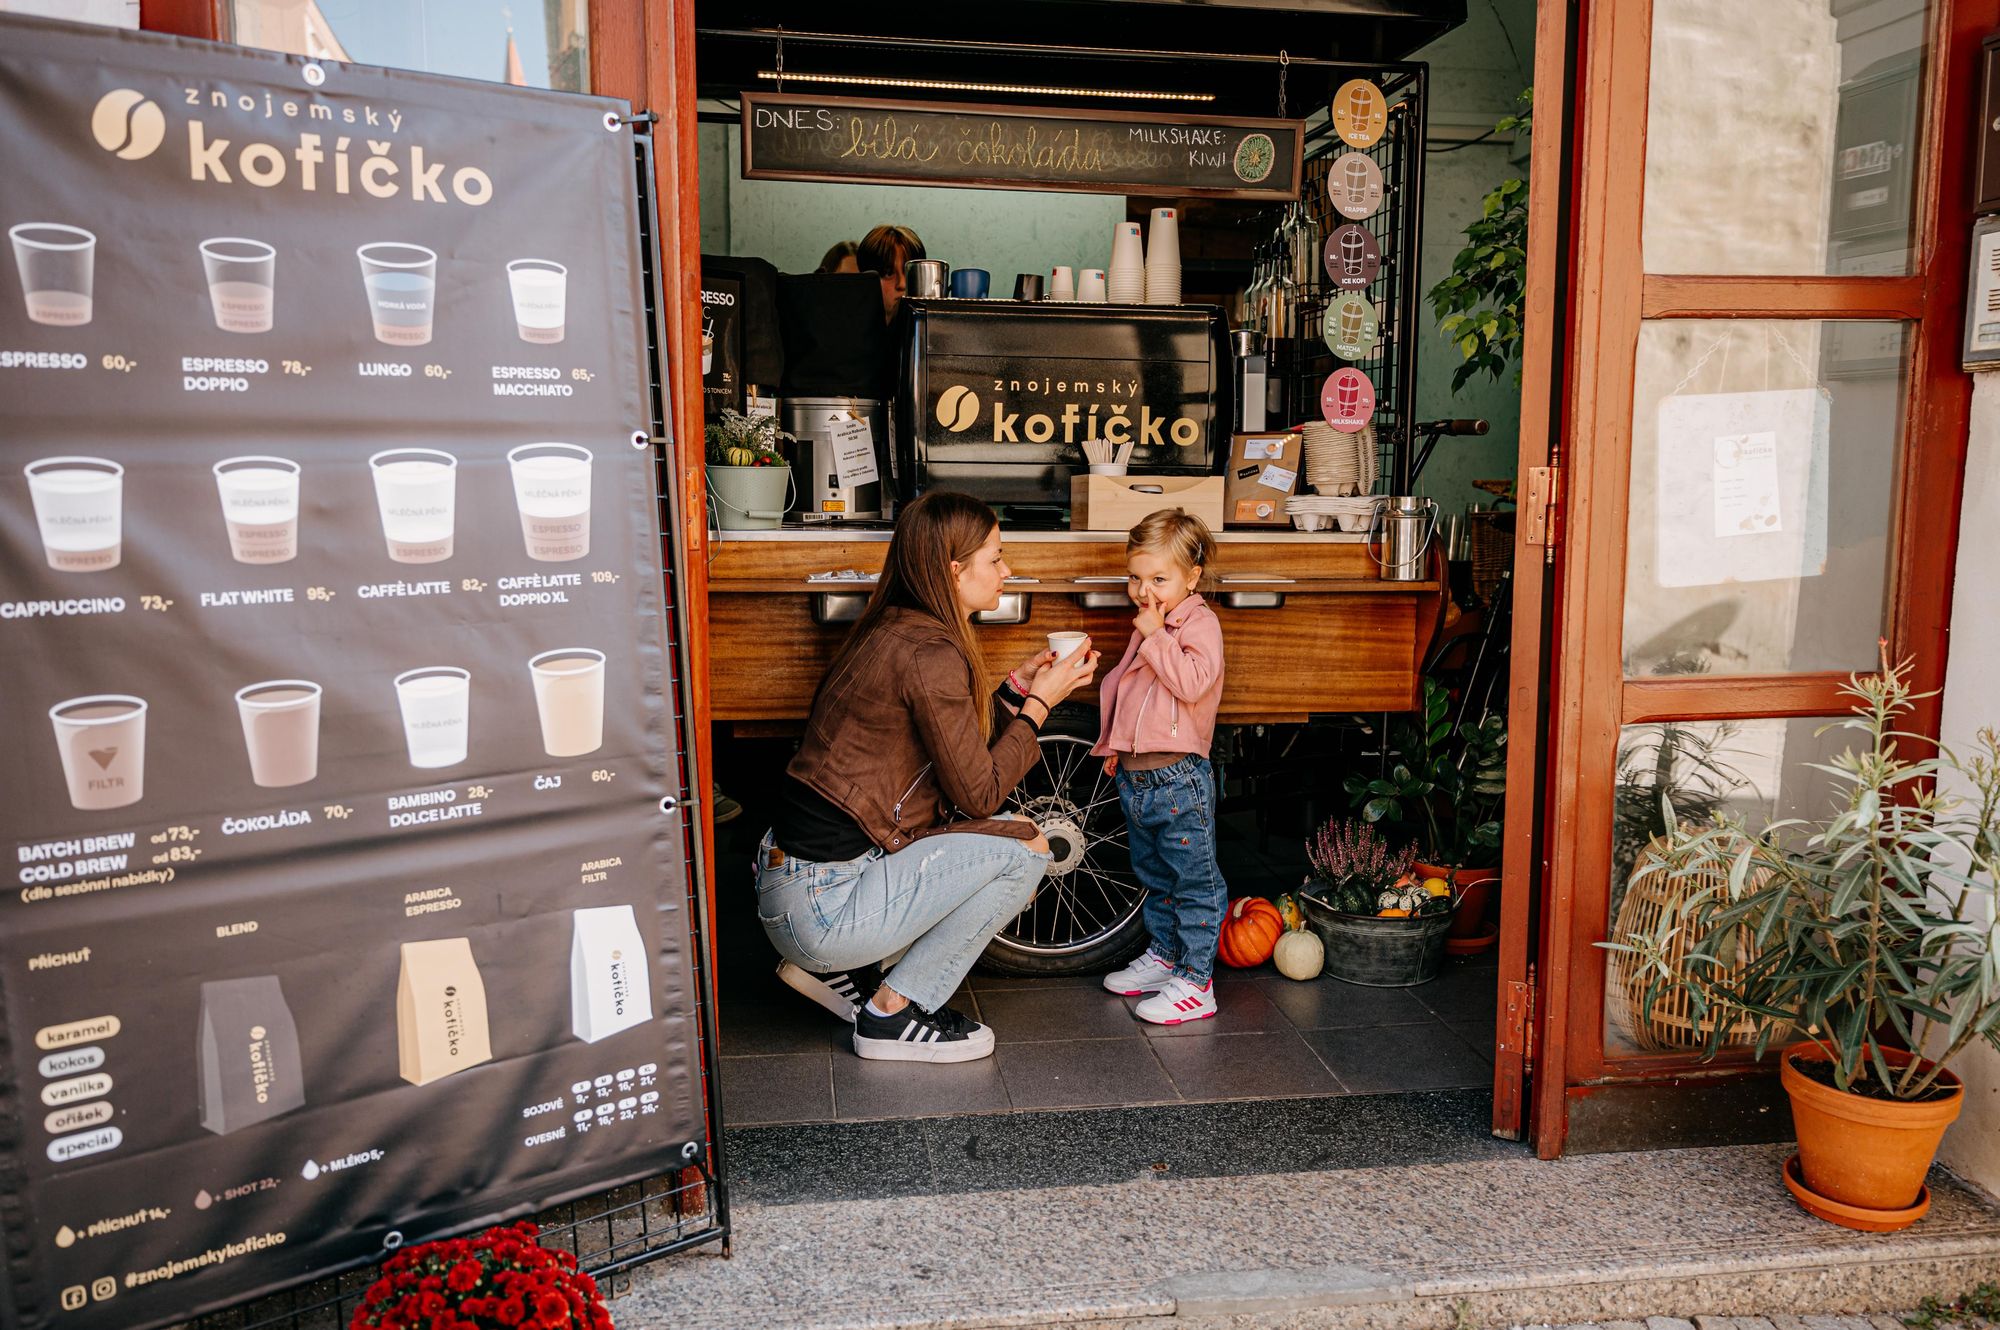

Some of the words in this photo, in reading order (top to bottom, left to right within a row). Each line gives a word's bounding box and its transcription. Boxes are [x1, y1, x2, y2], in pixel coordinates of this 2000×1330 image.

[186, 87, 403, 133] znojemský
[756, 108, 841, 131] DNES:
[841, 115, 939, 162] bílá
[1129, 127, 1227, 146] MILKSHAKE:
[188, 120, 494, 206] kofíčko
[1189, 150, 1226, 168] KIWI
[1336, 344, 1360, 353] MATCHA
[0, 351, 88, 369] SPRESSO
[102, 355, 137, 373] 60,-
[182, 357, 269, 374] ESPRESSO
[282, 361, 312, 376] 78,-
[358, 362, 412, 377] LUNGO
[424, 365, 452, 379] 60,-
[184, 376, 249, 392] DOPPIO
[492, 366, 561, 380] ESPRESSO
[571, 368, 596, 383] 65,-
[493, 384, 573, 397] MACCHIATO
[994, 378, 1138, 397] znojemský
[993, 402, 1200, 447] kofíčko
[237, 529, 289, 539] ESPRESSO
[532, 523, 582, 534] ESPRESSO
[396, 546, 447, 557] ESPRESSO
[534, 544, 583, 555] ESPRESSO
[358, 580, 407, 599] CAFFÈ
[407, 581, 451, 596] LATTE
[462, 579, 488, 593] 82,-
[497, 573, 541, 590] CAFFÈ
[541, 573, 582, 588] LATTE
[591, 571, 620, 585] 109,-
[0, 597, 126, 619] CAPPUCCINO
[140, 595, 174, 612] 73,-
[200, 591, 240, 607] FLAT
[240, 588, 294, 604] WHITE
[500, 592, 551, 607] DOPPIO
[552, 591, 569, 604] XL
[88, 777, 125, 791] FILTR
[534, 775, 562, 791] ČAJ
[591, 769, 616, 783] 60,-
[388, 789, 456, 811] BAMBINO
[467, 786, 494, 800] 28,-
[221, 810, 312, 836] ČOKOLÁDA
[324, 805, 354, 821] 70,-
[389, 807, 439, 828] DOLCE
[439, 803, 482, 822] LATTE
[18, 840, 81, 863] BATCH
[83, 832, 136, 854] BREW
[151, 831, 167, 844] od
[167, 826, 200, 842] 73,-
[19, 861, 74, 884] COLD
[75, 854, 128, 875] BREW
[152, 852, 169, 865] od
[169, 846, 202, 863] 83,-
[581, 857, 622, 872] ARABICA
[582, 871, 608, 884] FILTR
[21, 884, 53, 904] (dle
[404, 887, 452, 904] ARABICA
[405, 898, 462, 917] ESPRESSO
[216, 920, 259, 938] BLEND
[47, 1021, 111, 1045] karamel
[50, 1054, 96, 1072] kokos
[50, 1079, 105, 1100] vanilka
[55, 1106, 103, 1128] oříšek
[523, 1096, 564, 1119] SOJOVÉ
[57, 1131, 113, 1159] speciál
[524, 1126, 566, 1148] OVESNÉ
[225, 1181, 259, 1201] SHOT
[125, 1230, 287, 1288] #znojemskykoficko
